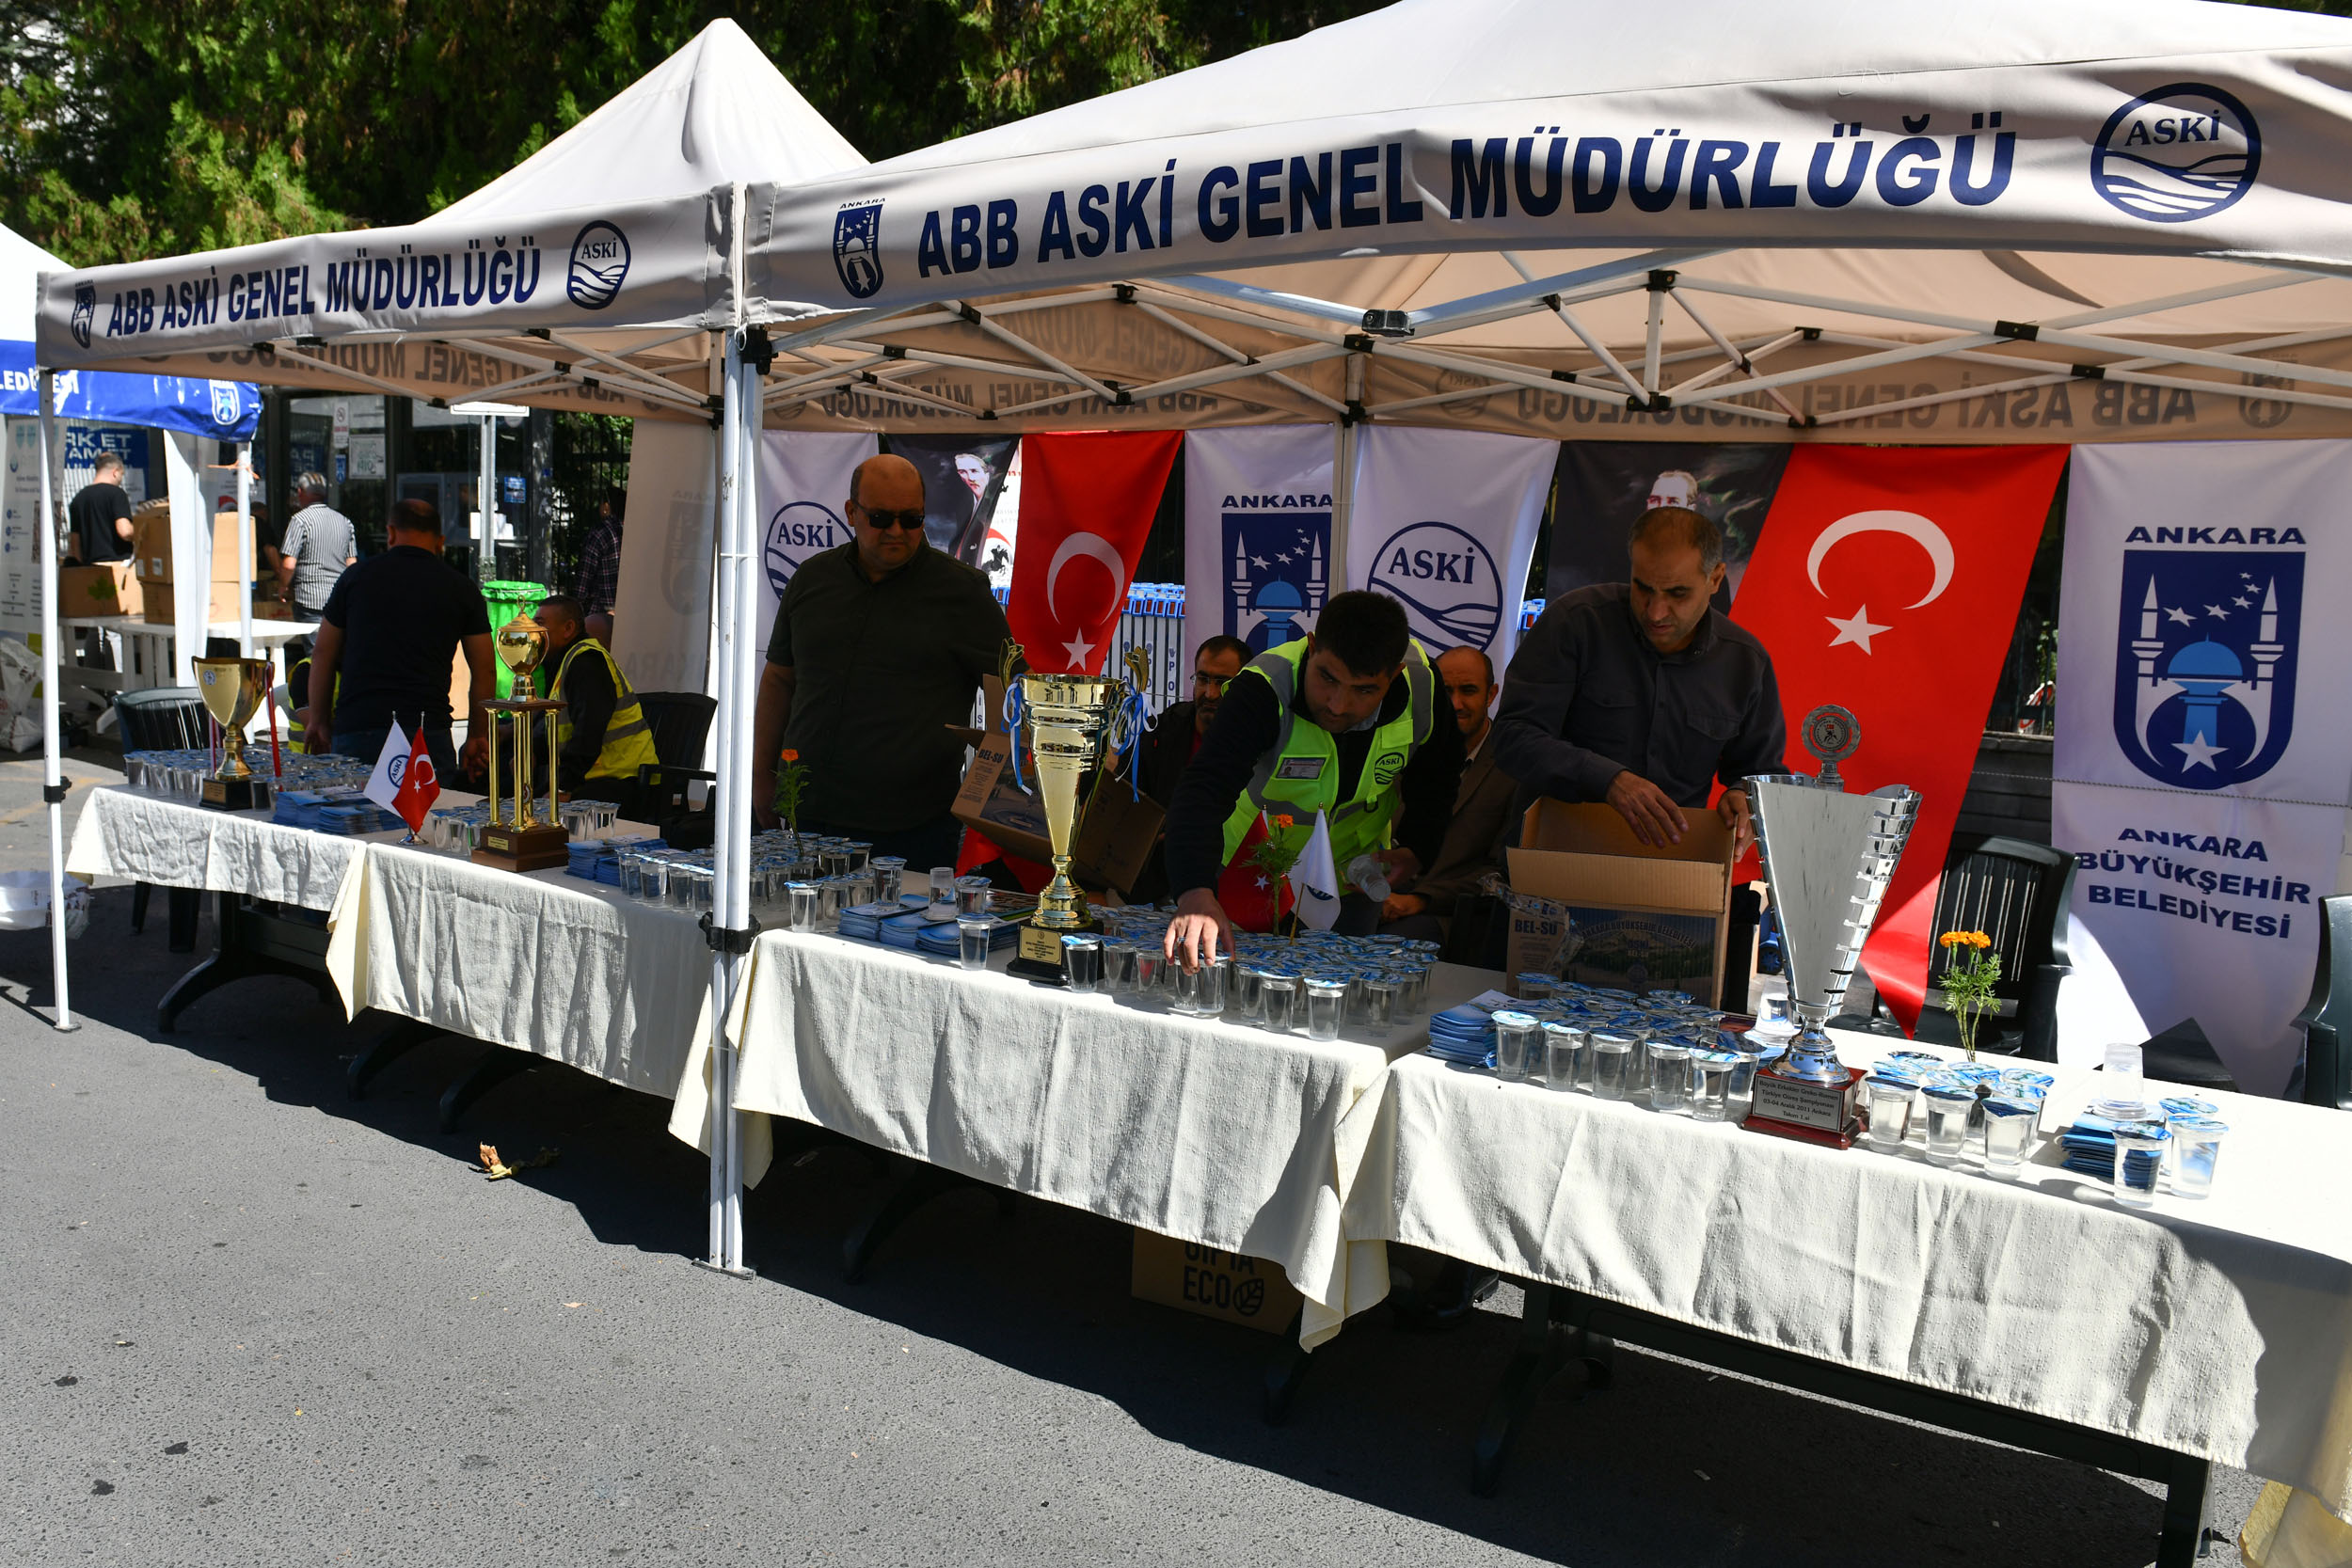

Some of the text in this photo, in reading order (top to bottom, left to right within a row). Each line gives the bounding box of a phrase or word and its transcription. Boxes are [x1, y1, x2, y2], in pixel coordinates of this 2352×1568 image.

[2122, 109, 2222, 149] ASKİ
[839, 197, 885, 209] ANKARA
[918, 112, 2015, 277] ABB ASKİ GENEL MÜDÜRLÜĞÜ
[581, 237, 617, 260] ASKİ
[106, 236, 540, 337] ABB ASKİ GENEL MÜDÜRLÜĞÜ
[1221, 494, 1333, 509] ANKARA
[777, 519, 834, 547] ASKİ
[2125, 526, 2306, 545] ANKARA
[1388, 546, 1474, 584] ASKİ
[2118, 828, 2268, 863] ANKARA
[2076, 851, 2311, 904] BÜYÜKŞEHİR
[1514, 918, 1558, 936] BEL-SU
[2088, 884, 2290, 939] BELEDİYESİ
[1762, 1089, 1781, 1099] Türkiye
[1763, 1098, 1779, 1106] 03-04
[1184, 1266, 1231, 1309] ECO
